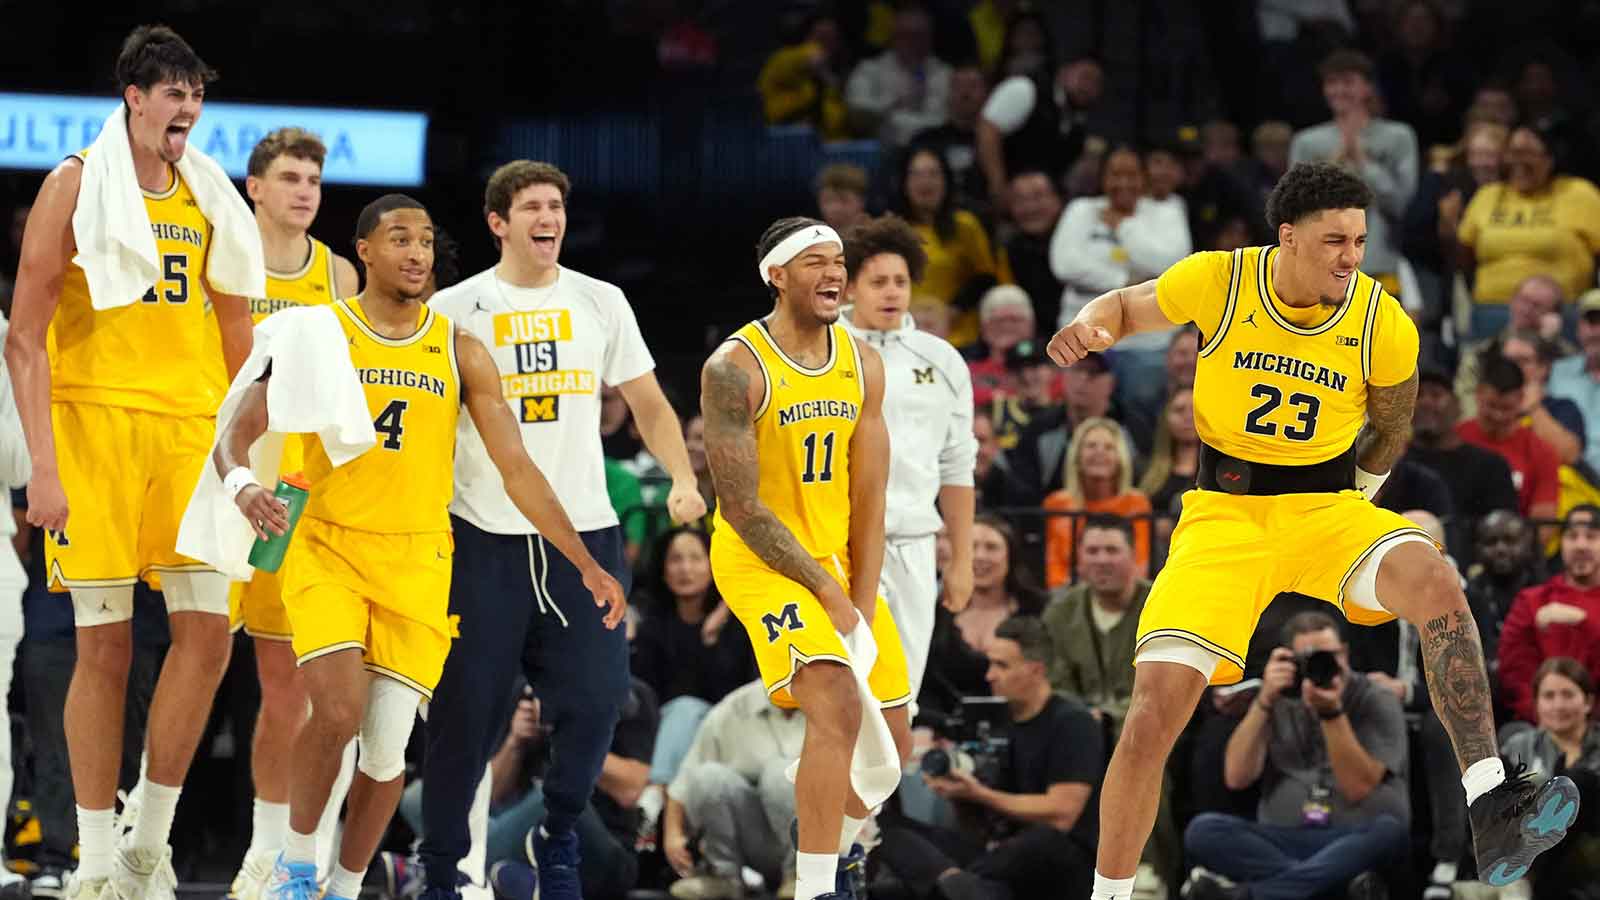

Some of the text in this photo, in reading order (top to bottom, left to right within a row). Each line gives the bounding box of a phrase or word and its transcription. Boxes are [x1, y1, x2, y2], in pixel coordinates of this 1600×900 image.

[204, 123, 359, 165] ARA
[151, 223, 203, 249] HIGAN
[503, 312, 562, 342] JUST
[520, 341, 554, 374] US
[1233, 351, 1348, 392] MICHIGAN
[355, 368, 446, 398] ICHIGAN
[911, 367, 937, 384] M
[373, 399, 408, 450] 4
[523, 396, 557, 422] M
[778, 400, 858, 427] MICHIGAN
[1245, 383, 1321, 441] 23
[802, 431, 835, 483] 11
[761, 603, 804, 643] M
[1425, 612, 1451, 636] WHY
